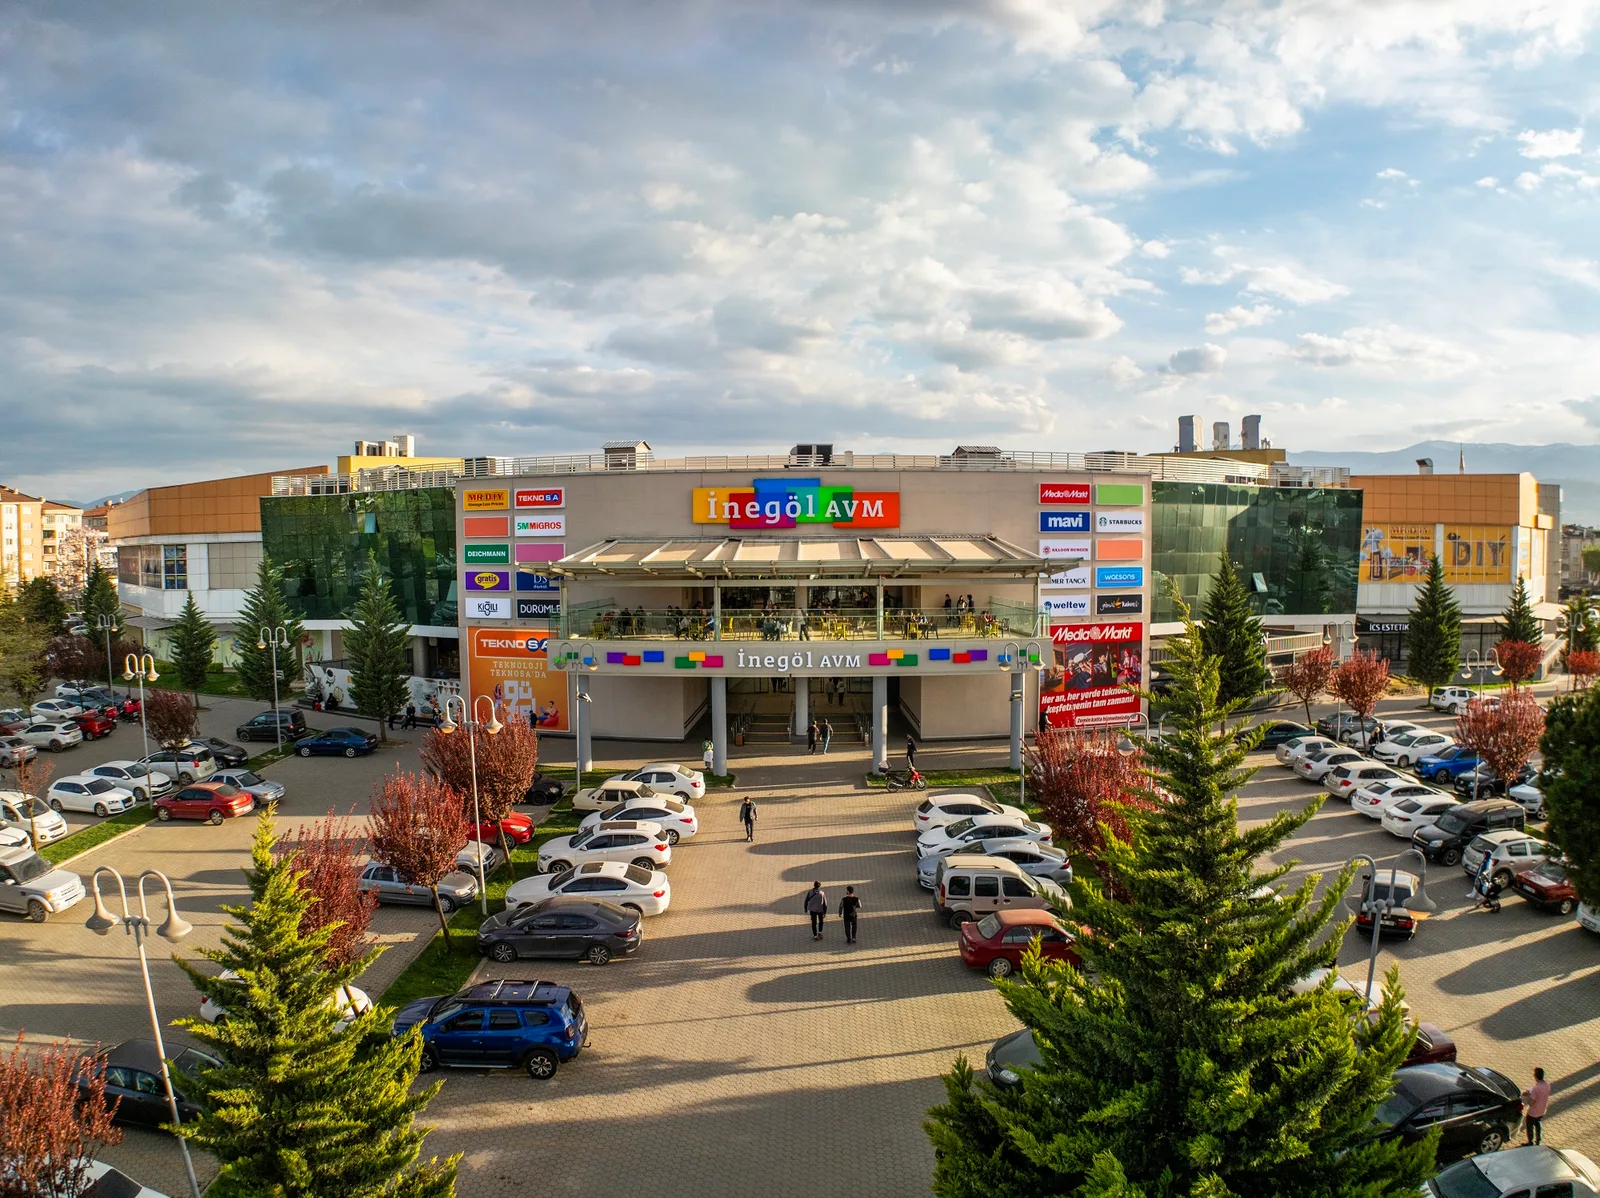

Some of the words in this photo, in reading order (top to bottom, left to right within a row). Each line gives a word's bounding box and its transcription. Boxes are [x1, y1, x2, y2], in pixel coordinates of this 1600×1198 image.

[518, 494, 559, 502] TEKNOSA
[707, 491, 816, 524] İnegöl
[825, 500, 884, 518] AVM
[1048, 514, 1083, 528] mavi
[477, 574, 497, 583] gratis
[1053, 601, 1086, 609] weltew
[738, 648, 813, 672] İnegöl
[820, 655, 861, 668] AVM
[1041, 695, 1055, 704] Her
[1055, 694, 1066, 702] an,
[1067, 692, 1080, 701] her
[1080, 690, 1101, 700] yerde
[1092, 699, 1107, 708] tam
